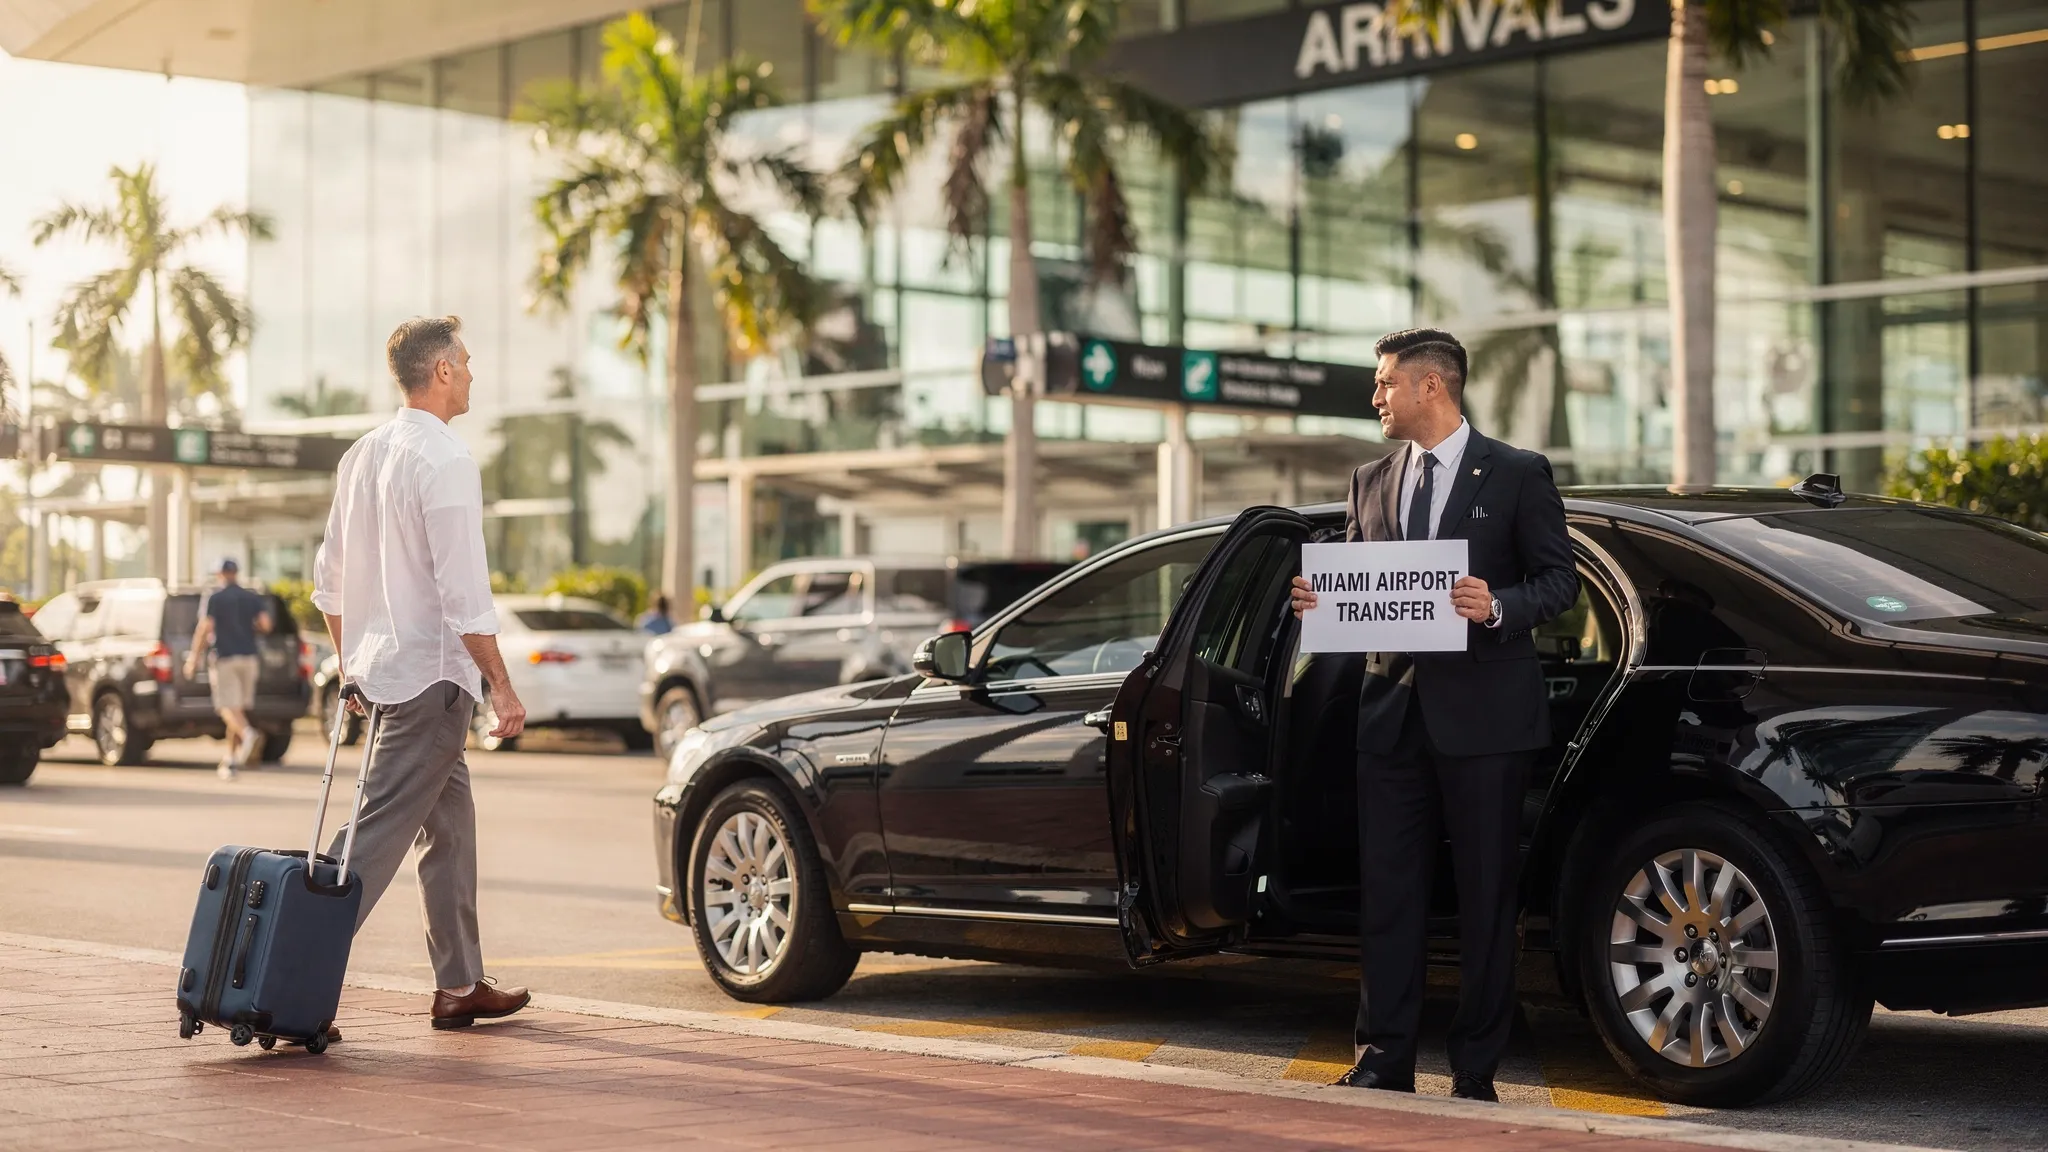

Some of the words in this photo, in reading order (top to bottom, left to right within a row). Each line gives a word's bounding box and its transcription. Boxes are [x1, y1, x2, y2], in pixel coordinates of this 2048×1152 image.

[1311, 572, 1370, 592] MIAMI
[1376, 570, 1459, 592] AIRPORT
[1336, 600, 1435, 622] TRANSFER
